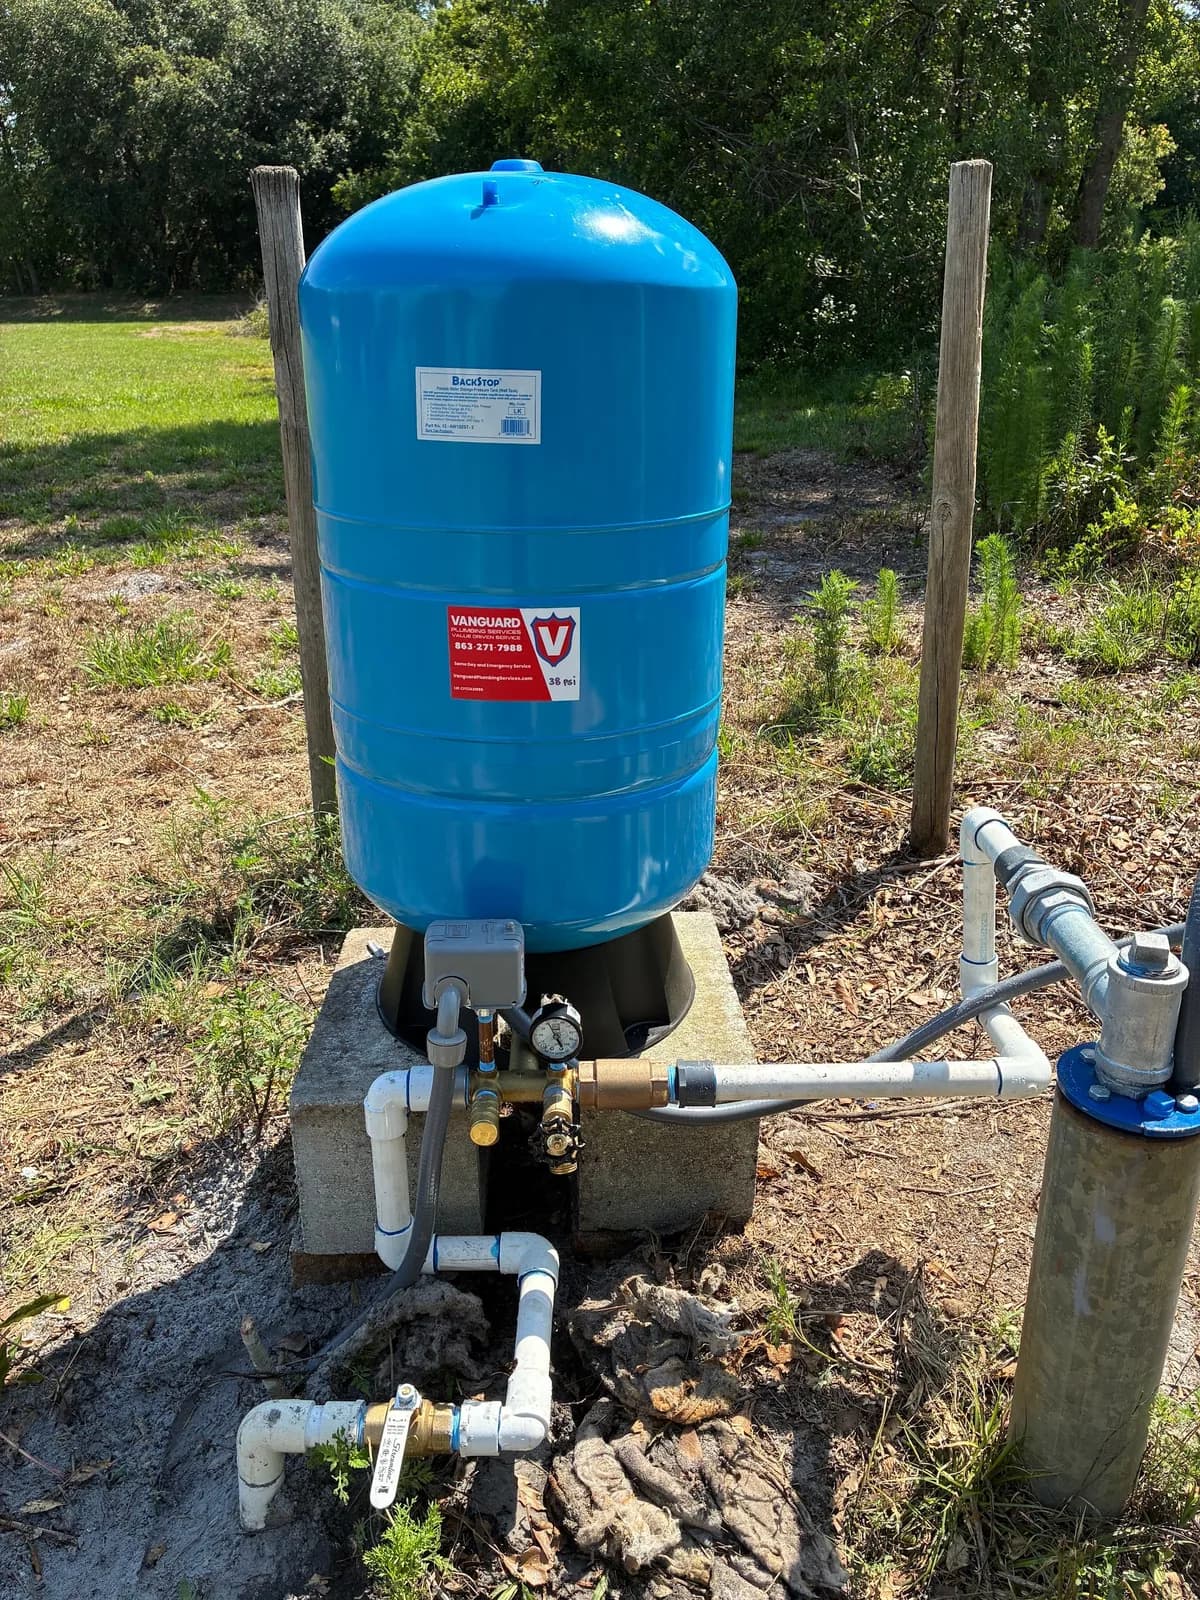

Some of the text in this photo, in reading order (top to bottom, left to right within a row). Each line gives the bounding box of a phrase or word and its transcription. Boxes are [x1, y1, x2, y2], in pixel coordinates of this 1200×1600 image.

[450, 615, 521, 628] VANGUARD
[538, 626, 569, 656] V
[454, 642, 523, 652] 863-271-7988
[548, 676, 576, 686] 38 psi
